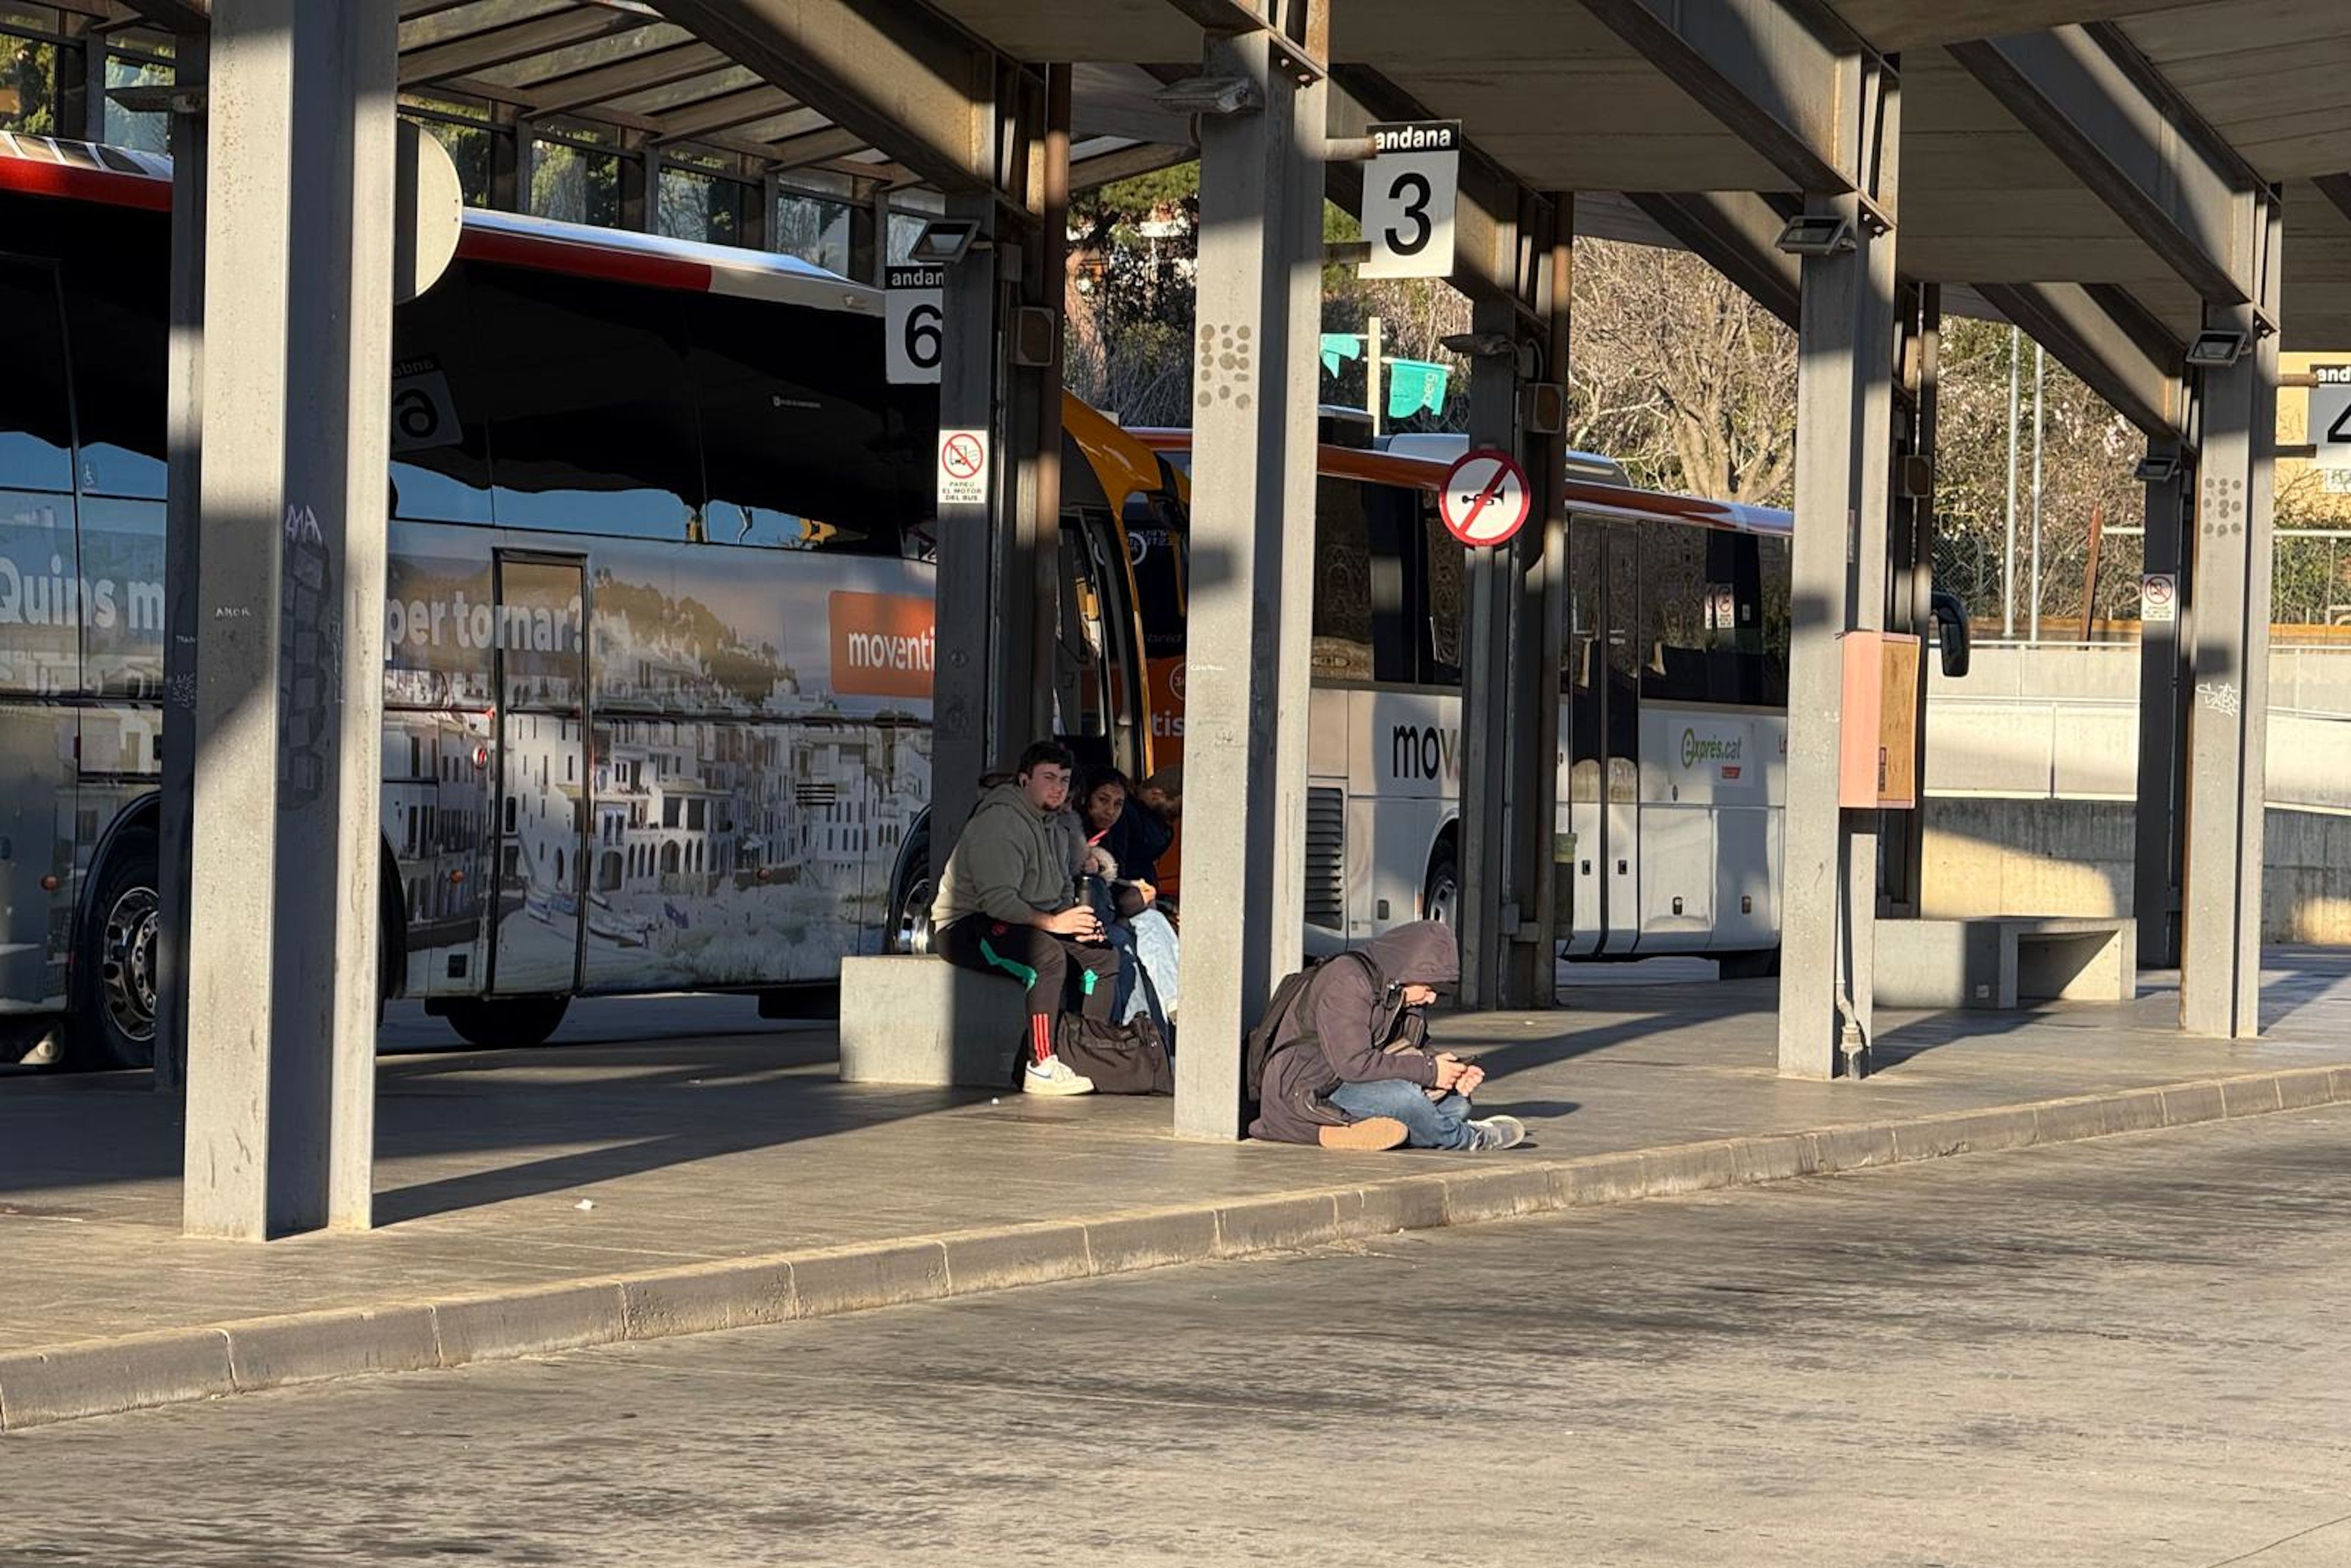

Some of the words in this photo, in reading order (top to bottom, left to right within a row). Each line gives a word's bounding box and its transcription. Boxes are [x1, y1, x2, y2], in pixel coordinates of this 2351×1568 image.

[1375, 125, 1452, 150] andana
[1385, 173, 1431, 256] 3
[905, 304, 943, 368] 6
[384, 598, 446, 660] per
[1393, 725, 1459, 780] mov
